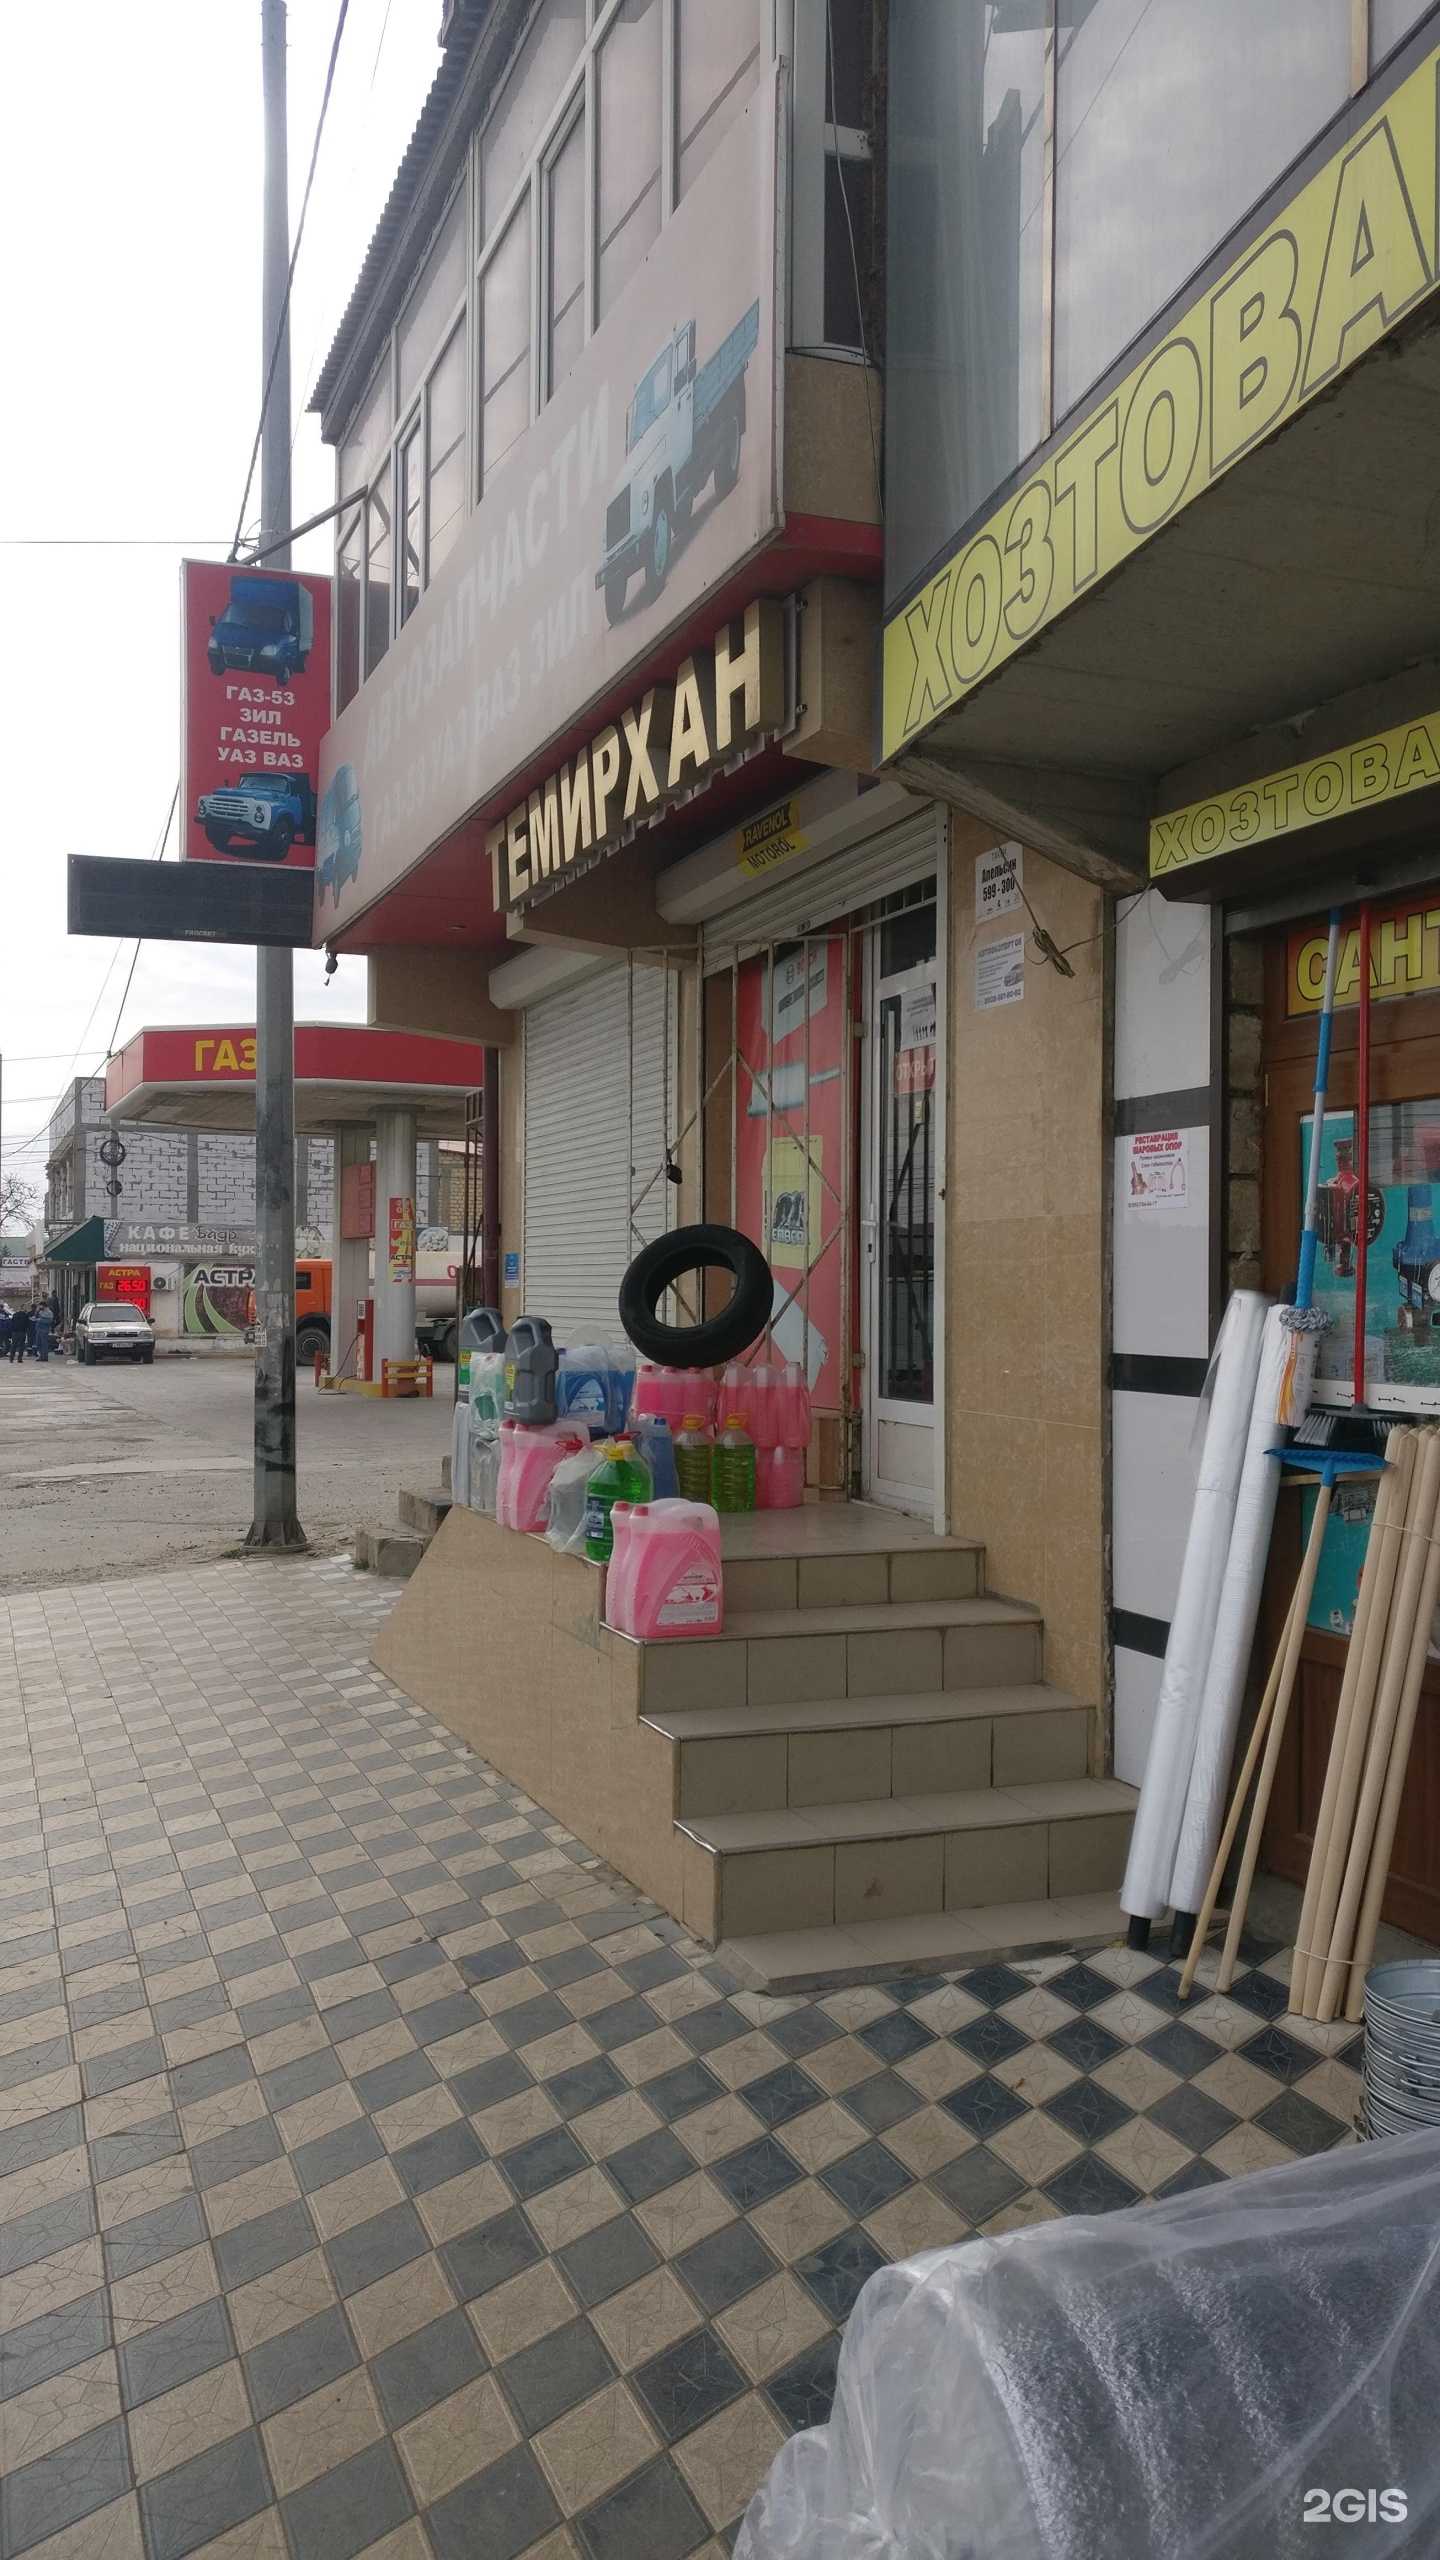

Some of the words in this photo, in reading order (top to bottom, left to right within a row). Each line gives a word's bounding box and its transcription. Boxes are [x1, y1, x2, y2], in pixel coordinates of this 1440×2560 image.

[903, 58, 1440, 737] ХОЗТОВА
[362, 380, 609, 780] АВТОЗАПЧАСТИ
[226, 685, 295, 706] ГАЗ-53
[239, 708, 281, 725] ЗИЛ
[220, 726, 301, 747] ГАЗЕЛЬ
[217, 747, 257, 764] УАЗ
[263, 751, 304, 768] ВАЗ
[485, 600, 761, 912] ТЕМИРХАН
[745, 805, 790, 849] RAVENOL
[982, 858, 1017, 883] Апельсин
[195, 1038, 256, 1072] ГАЗ
[128, 1226, 190, 1241] КАФЕ
[119, 1243, 223, 1256] национальная
[228, 1243, 256, 1257] кух
[108, 1269, 141, 1277] АСТРА
[194, 1268, 256, 1285] АСТР
